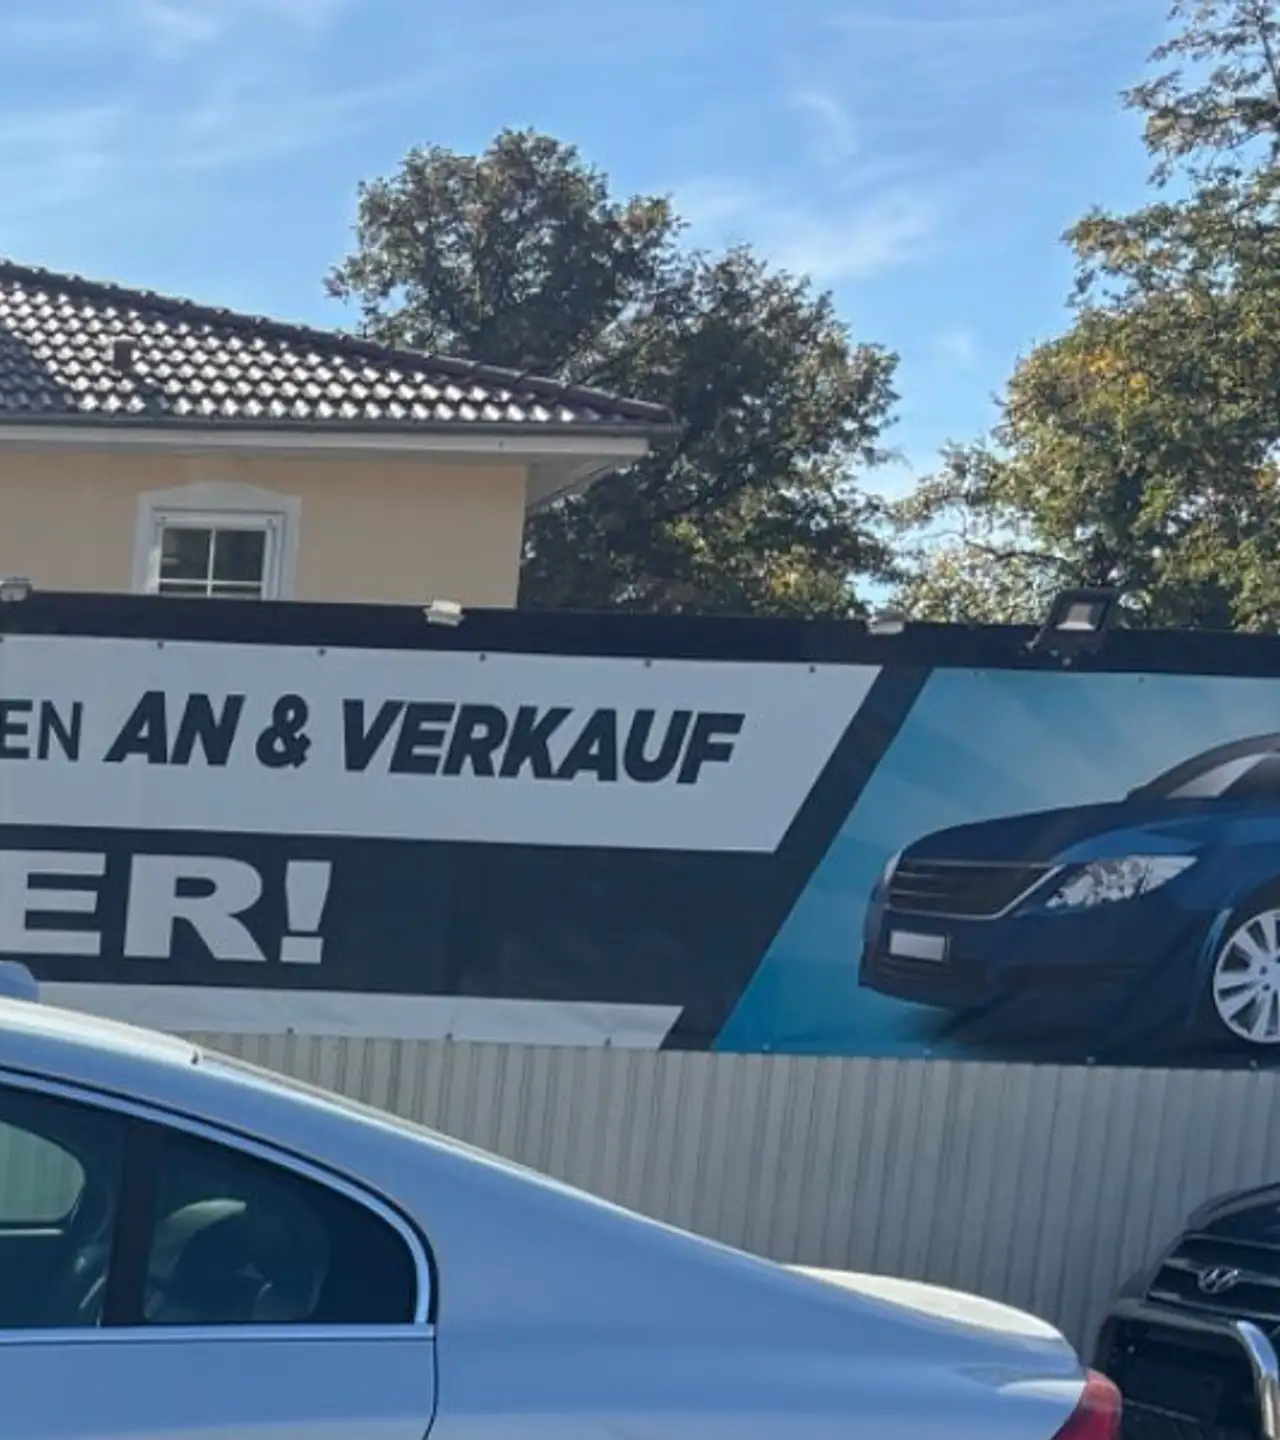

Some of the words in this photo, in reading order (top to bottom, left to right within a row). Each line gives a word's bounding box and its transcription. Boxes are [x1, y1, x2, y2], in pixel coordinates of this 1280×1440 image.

[104, 690, 245, 768] AN
[255, 693, 313, 770] &
[341, 697, 746, 785] VERKAUF
